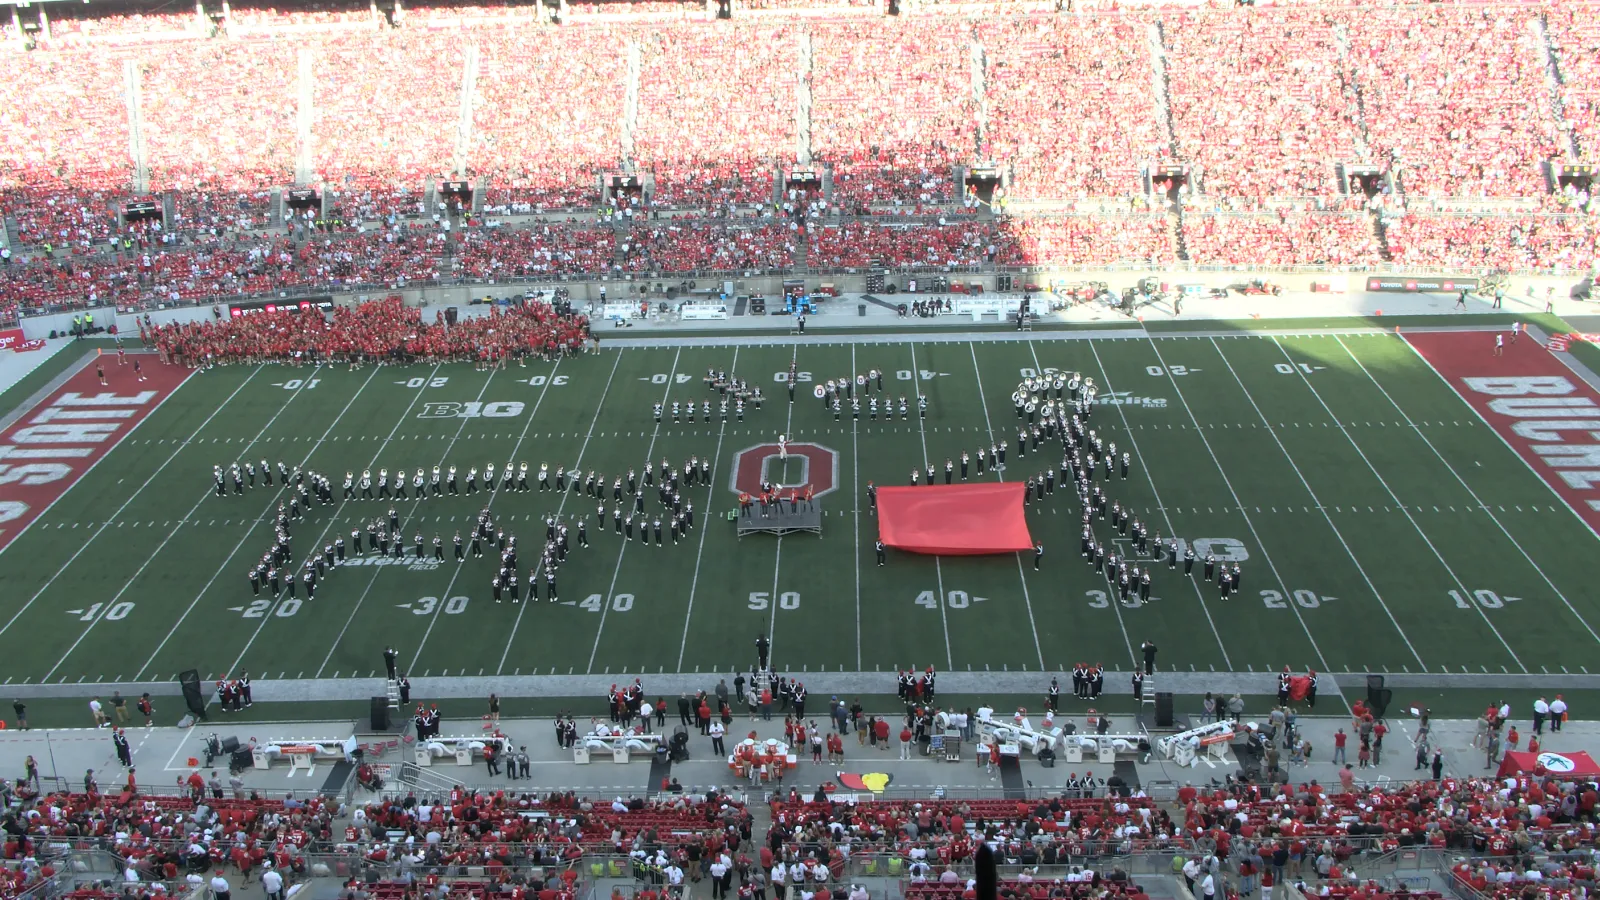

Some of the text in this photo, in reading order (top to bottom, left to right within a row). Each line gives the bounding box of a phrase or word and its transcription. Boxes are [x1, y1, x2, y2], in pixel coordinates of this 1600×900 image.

[896, 369, 937, 380] 40
[1146, 365, 1189, 376] 20
[1274, 363, 1313, 374] 10
[282, 378, 321, 390] 10
[406, 377, 449, 388] 20
[529, 375, 569, 386] 30
[651, 373, 692, 384] 40
[774, 371, 812, 382] 50
[412, 596, 470, 615] 30
[579, 593, 635, 612] 40
[747, 591, 801, 610] 50
[914, 590, 970, 609] 40
[1259, 589, 1320, 608] 20
[1448, 589, 1504, 609] 10
[80, 601, 136, 621] 10
[241, 599, 303, 618] 20
